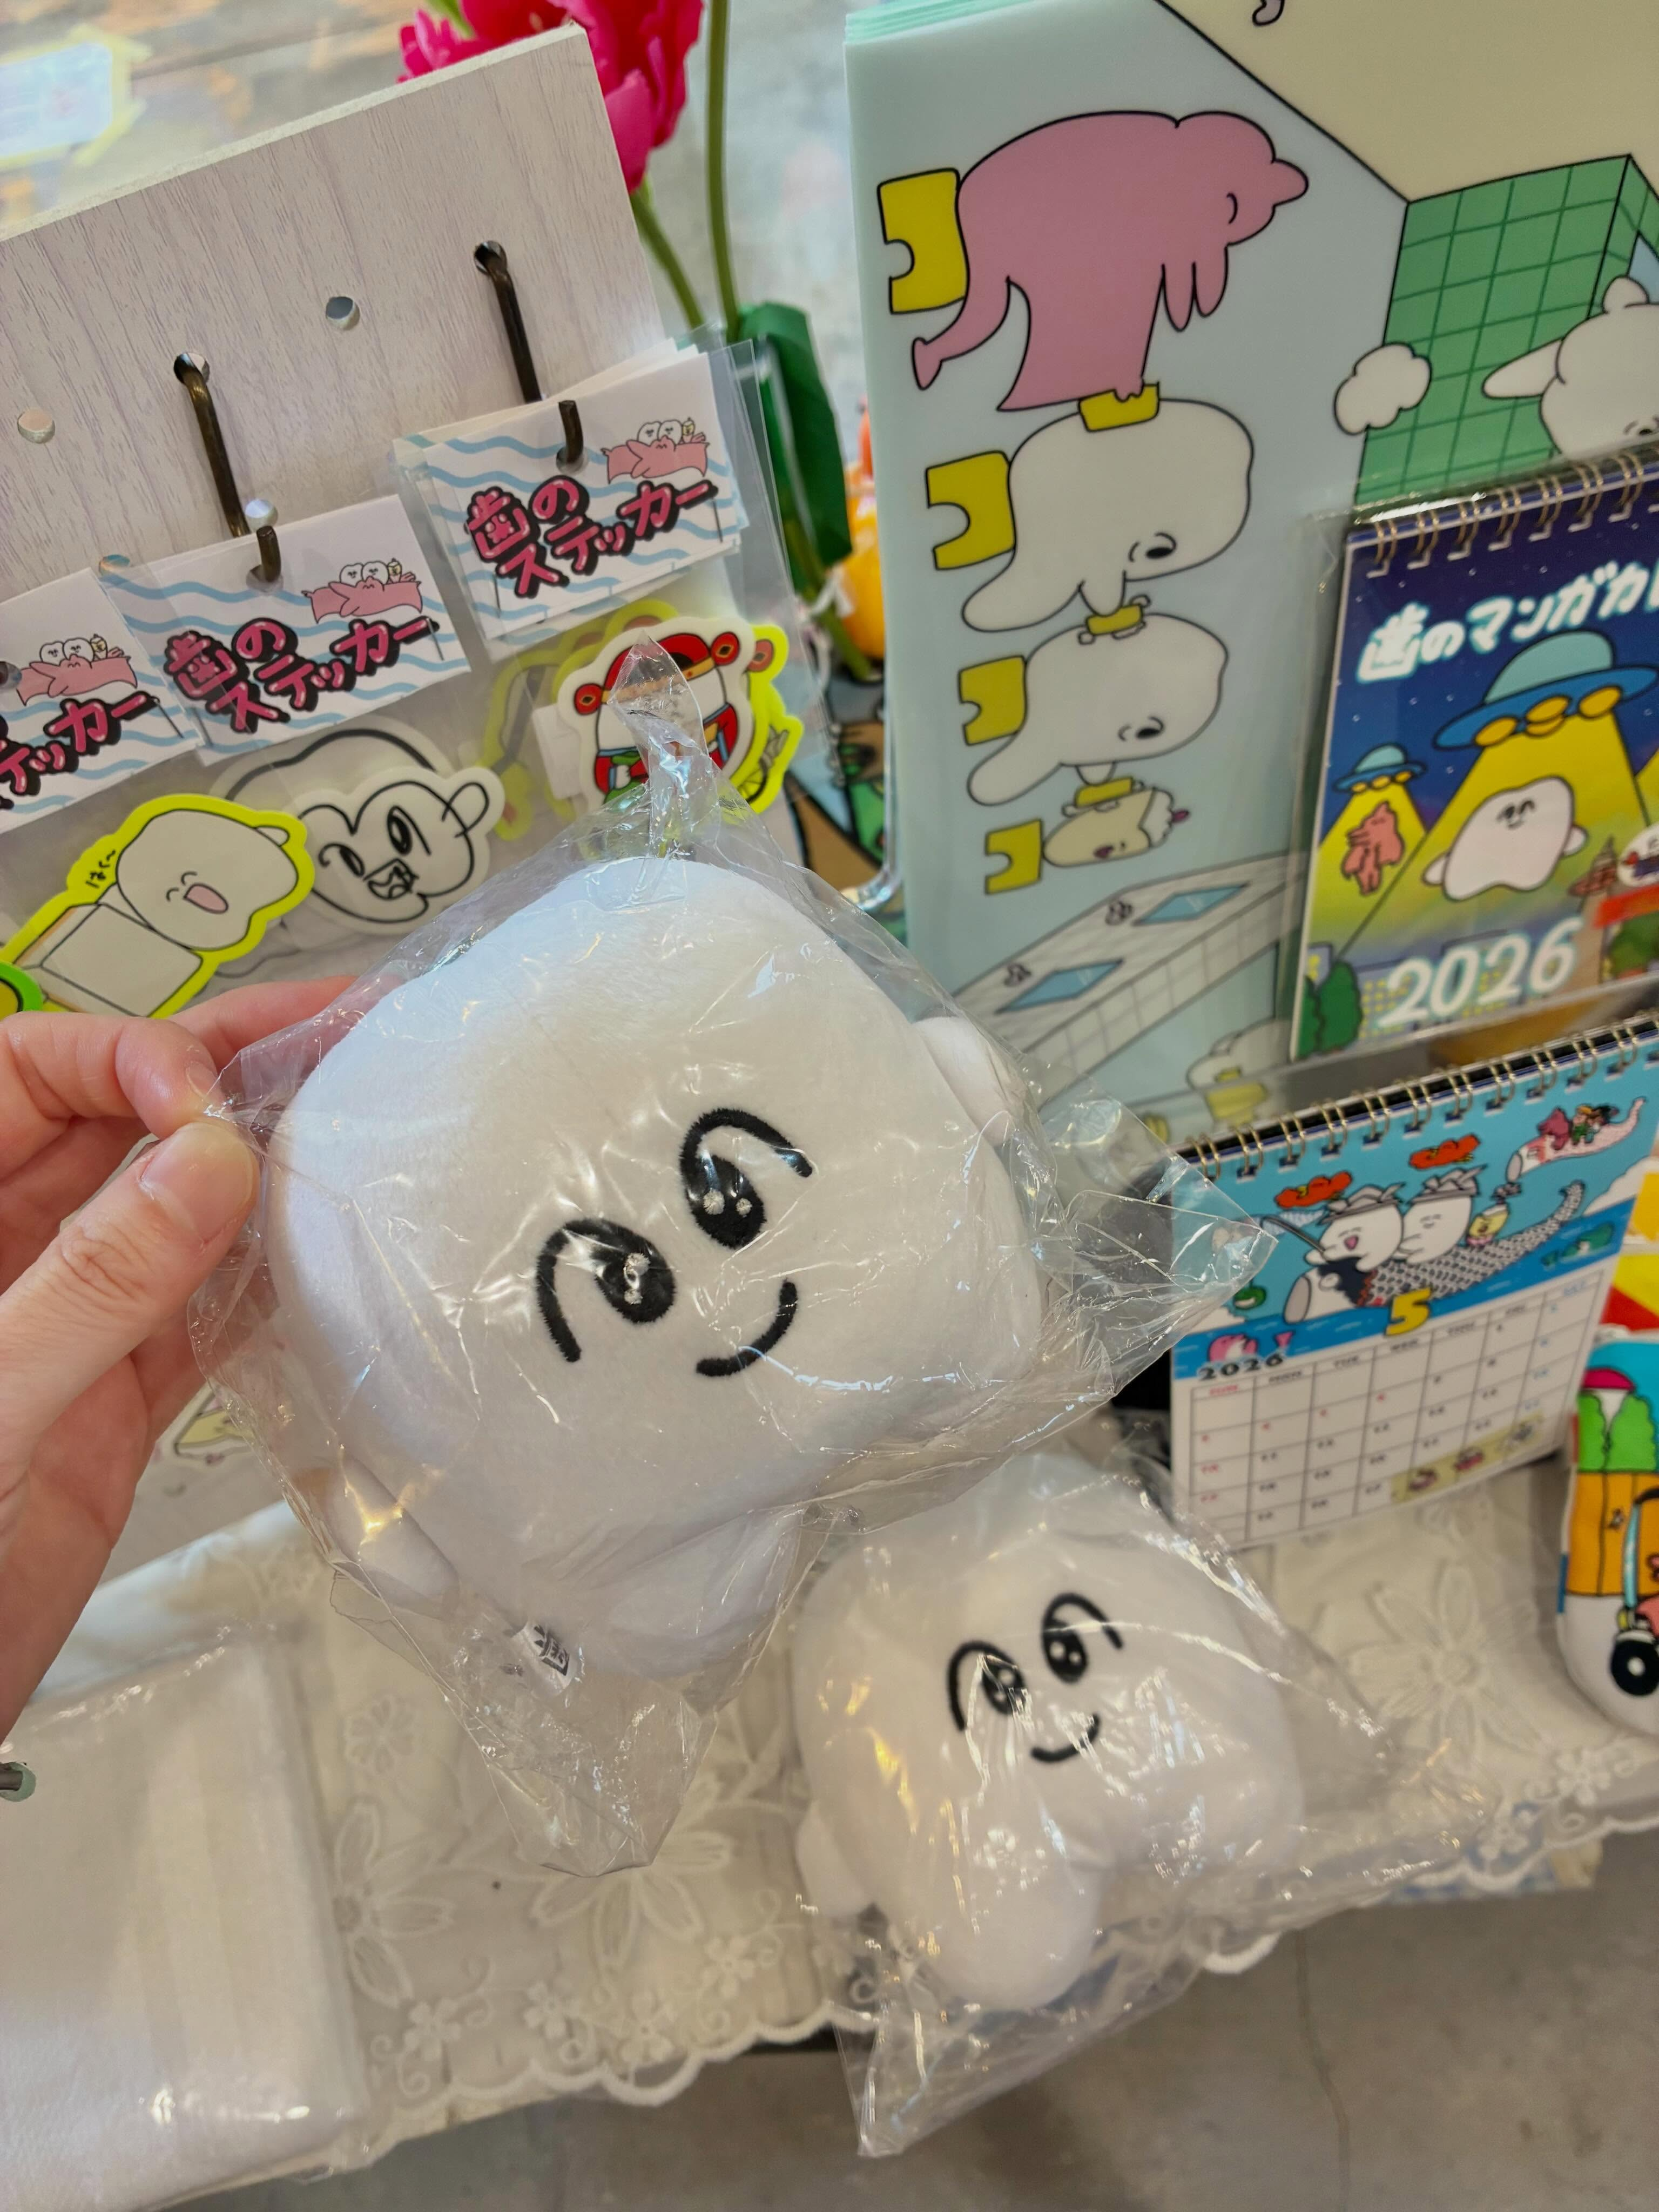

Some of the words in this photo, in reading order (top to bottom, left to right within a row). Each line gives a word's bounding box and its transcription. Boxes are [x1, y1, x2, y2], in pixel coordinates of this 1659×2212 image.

[465, 475, 590, 562] 歯の
[495, 479, 718, 598] ステッカー
[163, 617, 298, 701] 歯の
[204, 617, 440, 734] ステッカー
[1377, 916, 1584, 1028] 2026
[1383, 1286, 1432, 1337] 5
[1198, 1351, 1285, 1381] 2026
